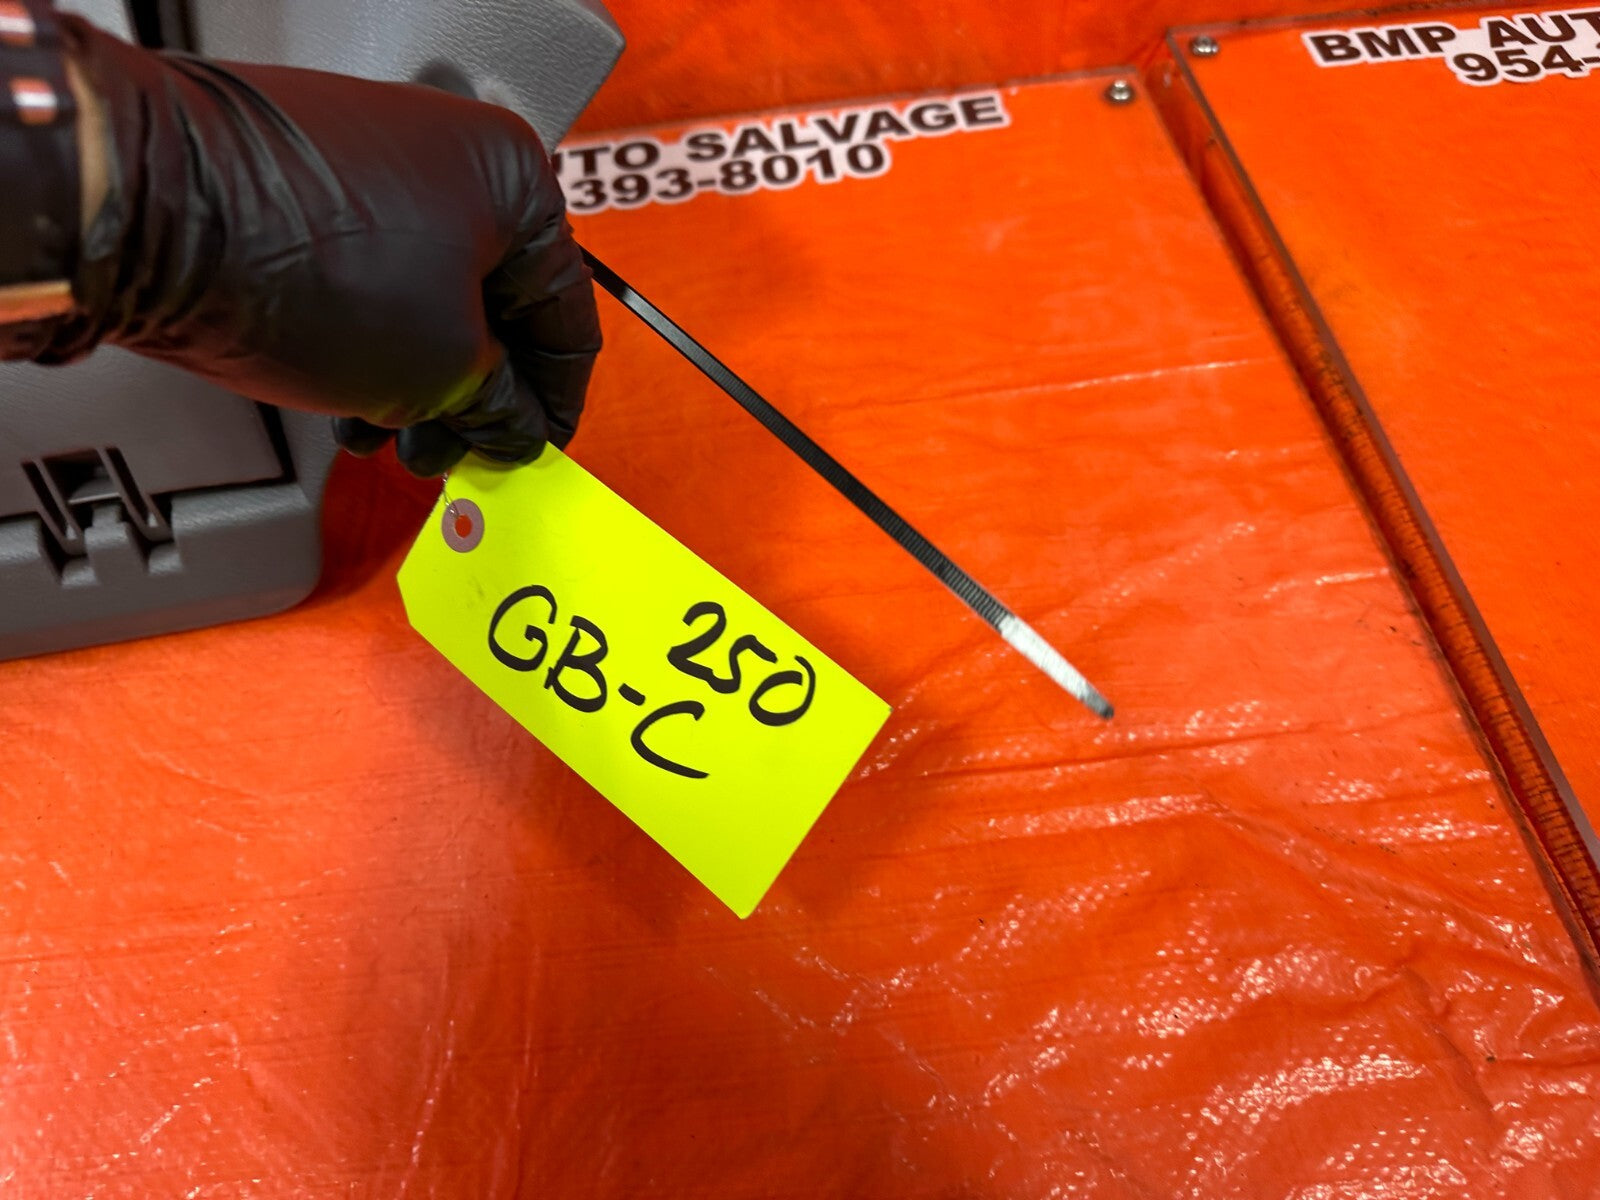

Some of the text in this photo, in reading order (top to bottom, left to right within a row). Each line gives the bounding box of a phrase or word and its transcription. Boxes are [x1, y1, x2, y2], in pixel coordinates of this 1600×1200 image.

[1309, 25, 1456, 61] BMP
[1453, 44, 1600, 81] 954-
[687, 96, 1004, 161] SALVAGE
[570, 143, 884, 210] 393-8010
[488, 584, 709, 778] GB-C
[667, 601, 815, 726] 250
